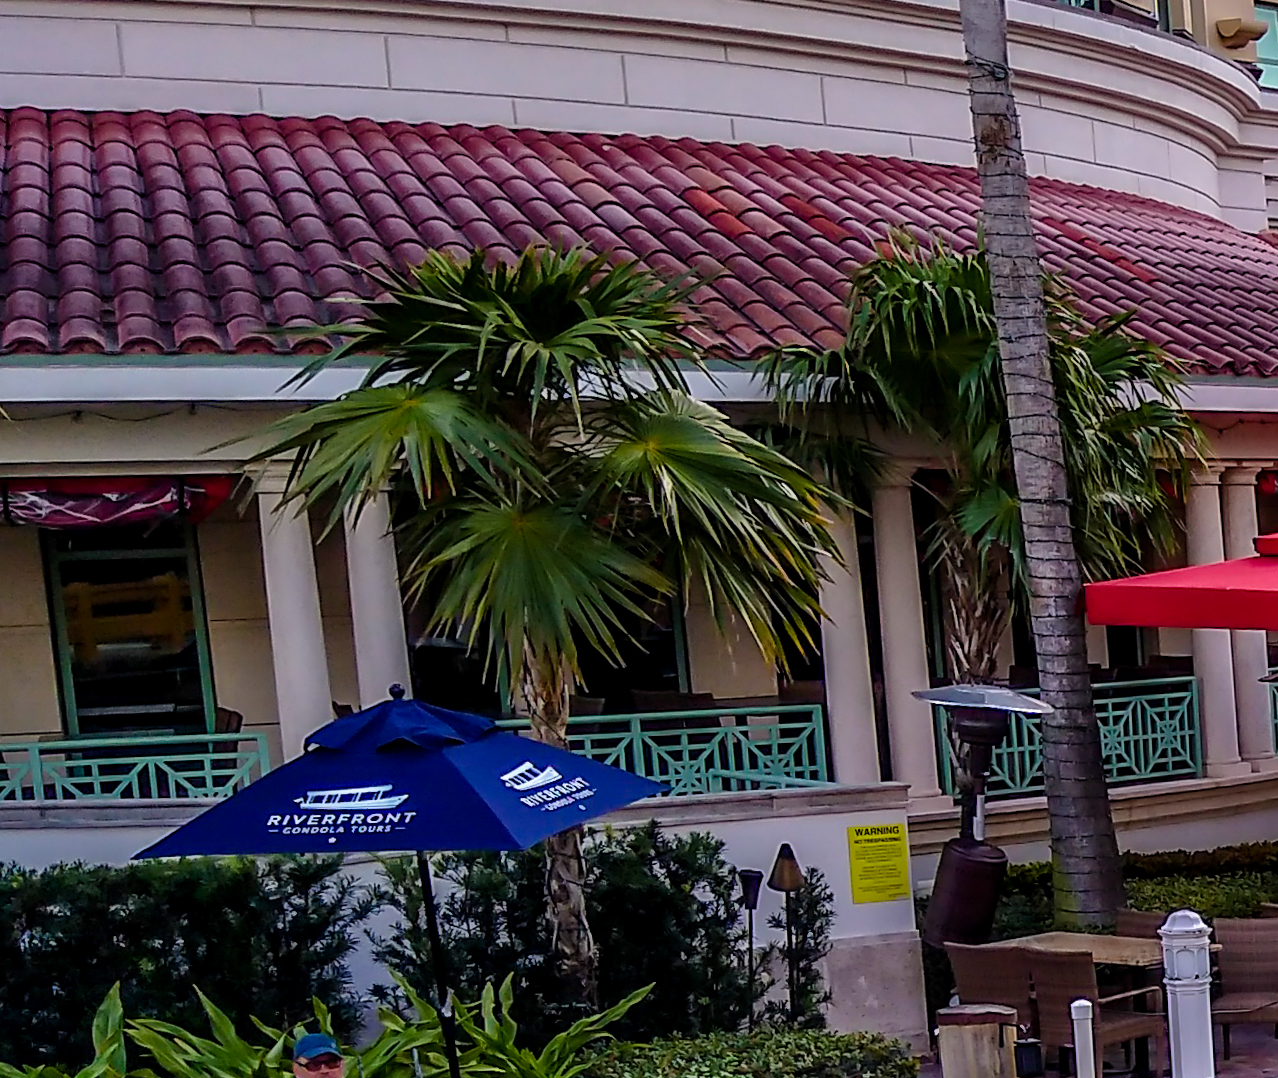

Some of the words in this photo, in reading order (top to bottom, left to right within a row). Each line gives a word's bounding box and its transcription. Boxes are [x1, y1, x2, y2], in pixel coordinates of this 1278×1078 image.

[520, 777, 590, 807] RIVERFRONT
[267, 812, 416, 826] RIVERFRONT
[282, 826, 345, 834] GONDOLA
[351, 825, 391, 833] TOURS
[854, 826, 899, 836] WARNING
